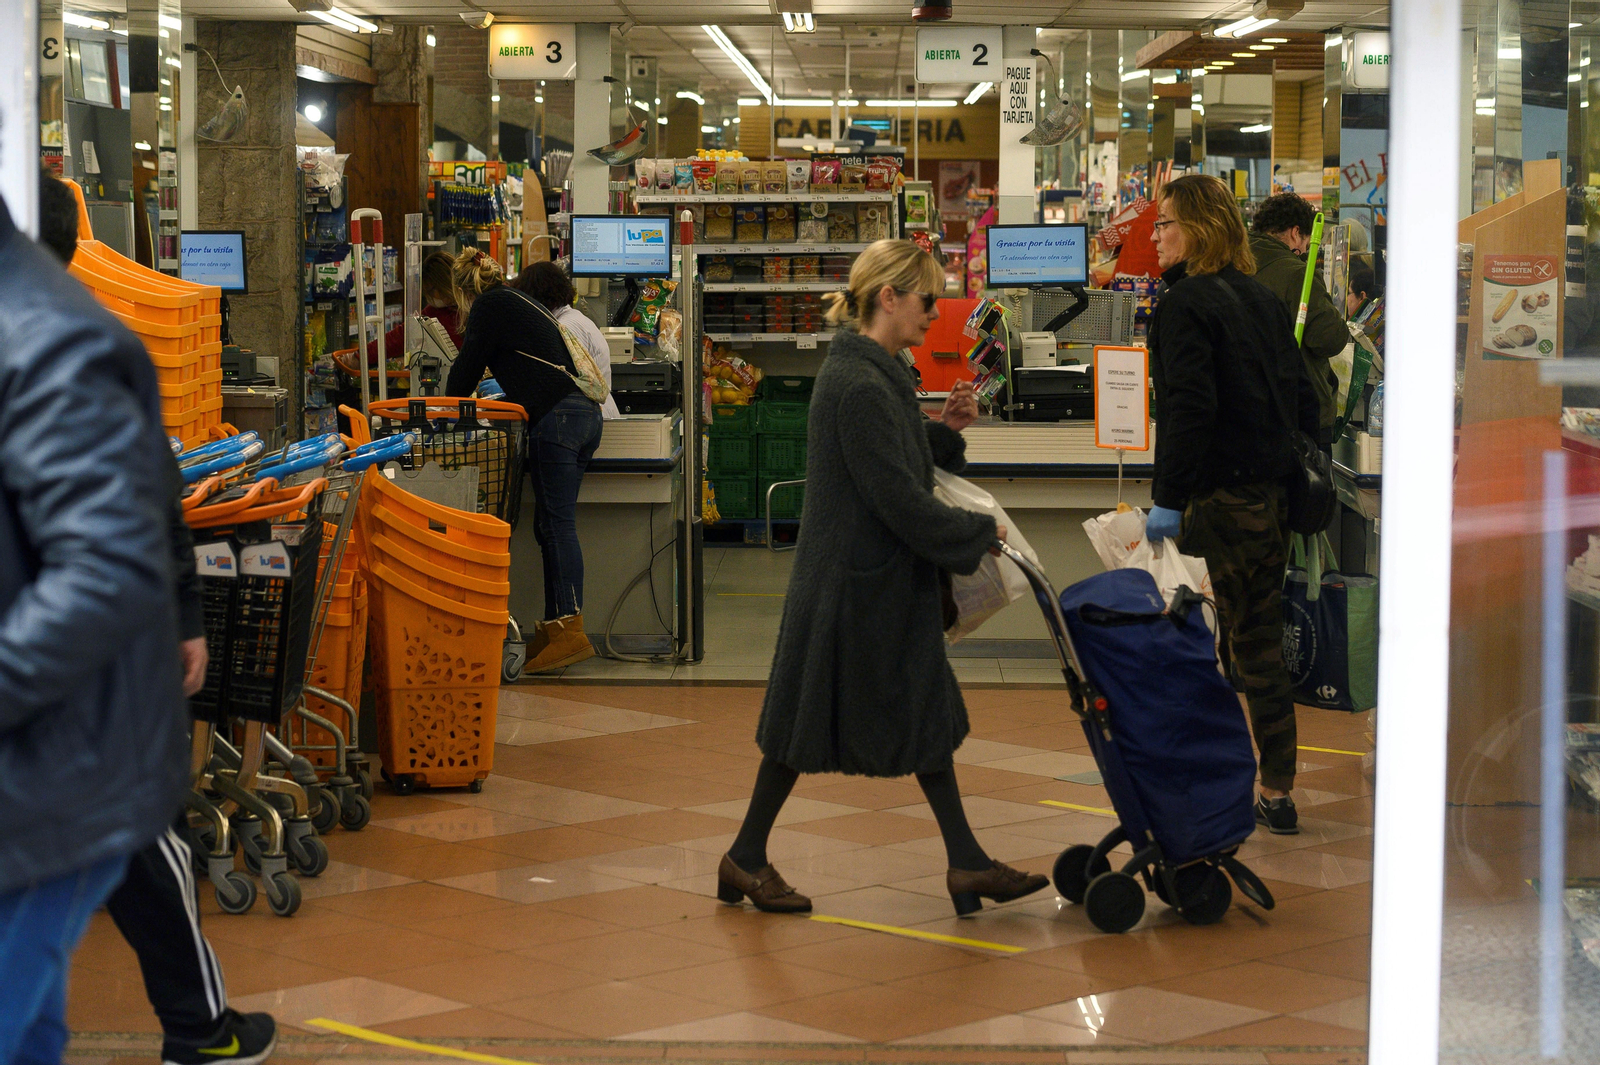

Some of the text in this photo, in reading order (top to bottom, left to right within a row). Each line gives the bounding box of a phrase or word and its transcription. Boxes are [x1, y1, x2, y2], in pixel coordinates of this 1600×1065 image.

[499, 41, 562, 64] ABIERTA 3
[924, 44, 988, 66] ABIERTA 2
[1006, 67, 1031, 80] PAGUE
[1009, 82, 1028, 95] AQUI
[1010, 96, 1027, 109] CON
[1002, 111, 1034, 124] TARJETA
[774, 118, 966, 143] CARERIA
[626, 229, 664, 243] lupa
[996, 240, 1027, 248] Gracias
[1028, 240, 1043, 250] por
[188, 247, 202, 257] por
